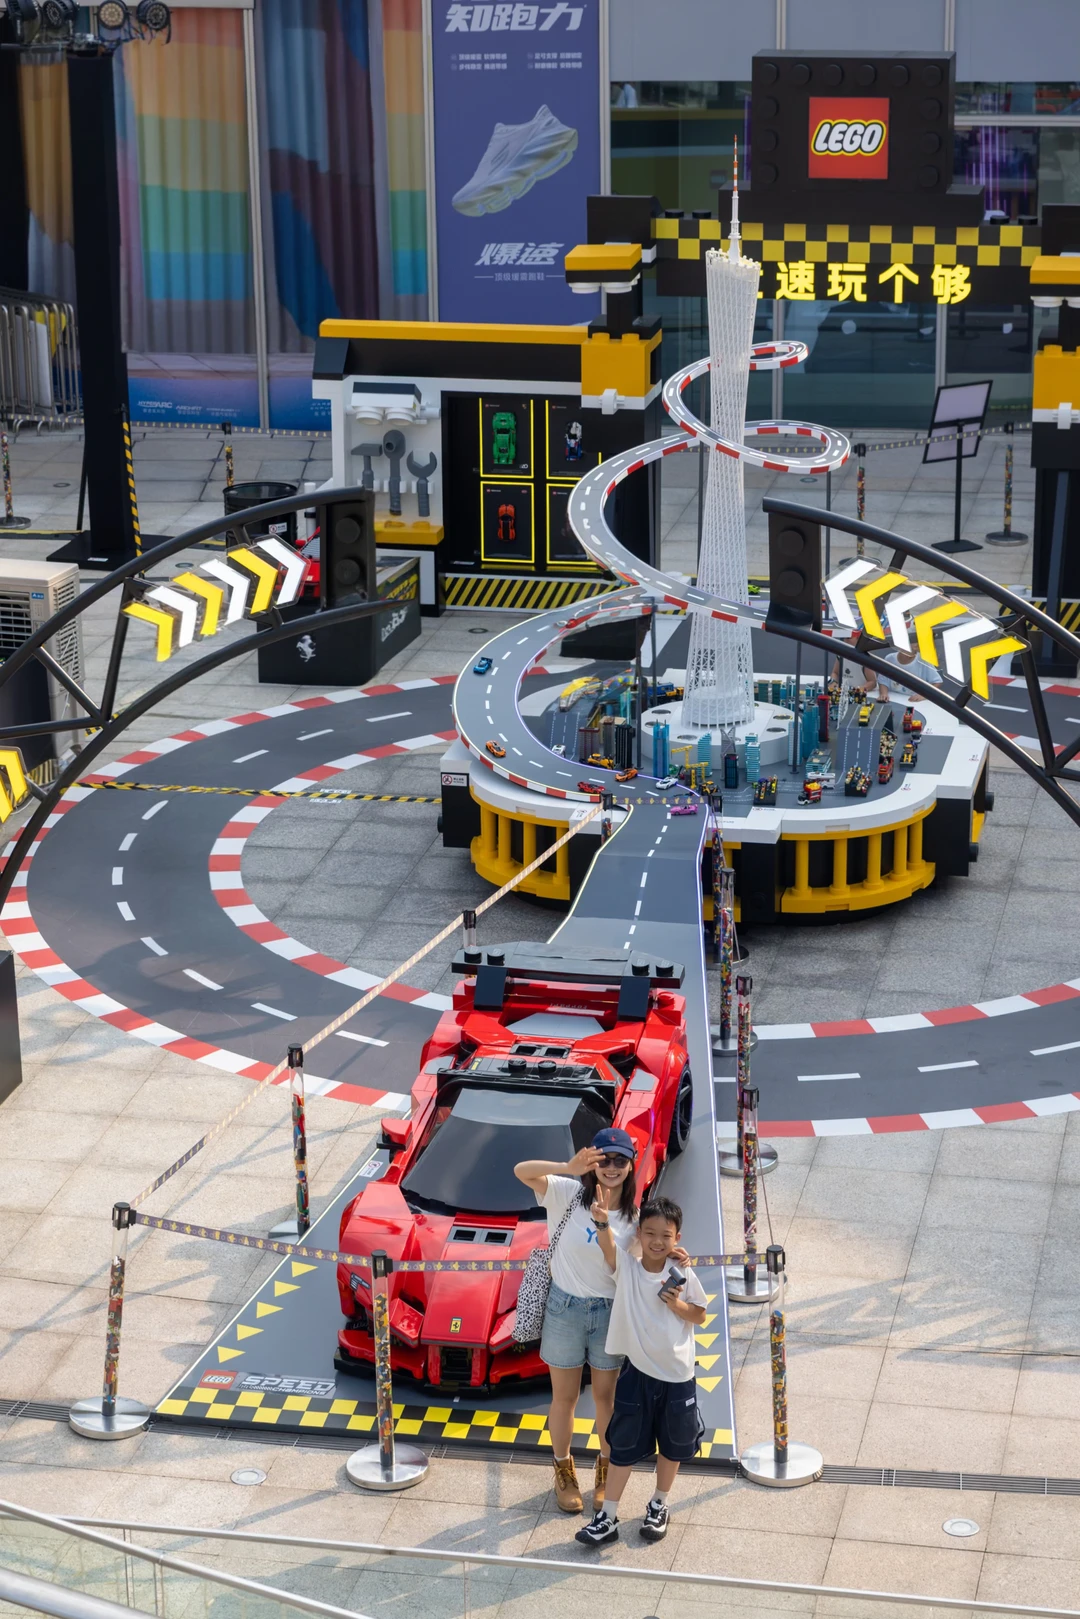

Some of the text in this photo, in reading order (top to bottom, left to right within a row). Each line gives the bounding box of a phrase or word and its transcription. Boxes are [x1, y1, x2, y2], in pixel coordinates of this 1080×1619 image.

[445, 2, 584, 32] 知跑力
[813, 121, 885, 154] LEGO
[474, 242, 565, 266] 爆速
[757, 260, 972, 305] 速玩个够
[203, 1375, 336, 1392] LEGO SPEED
[272, 1387, 327, 1396] CHAMPIONS
